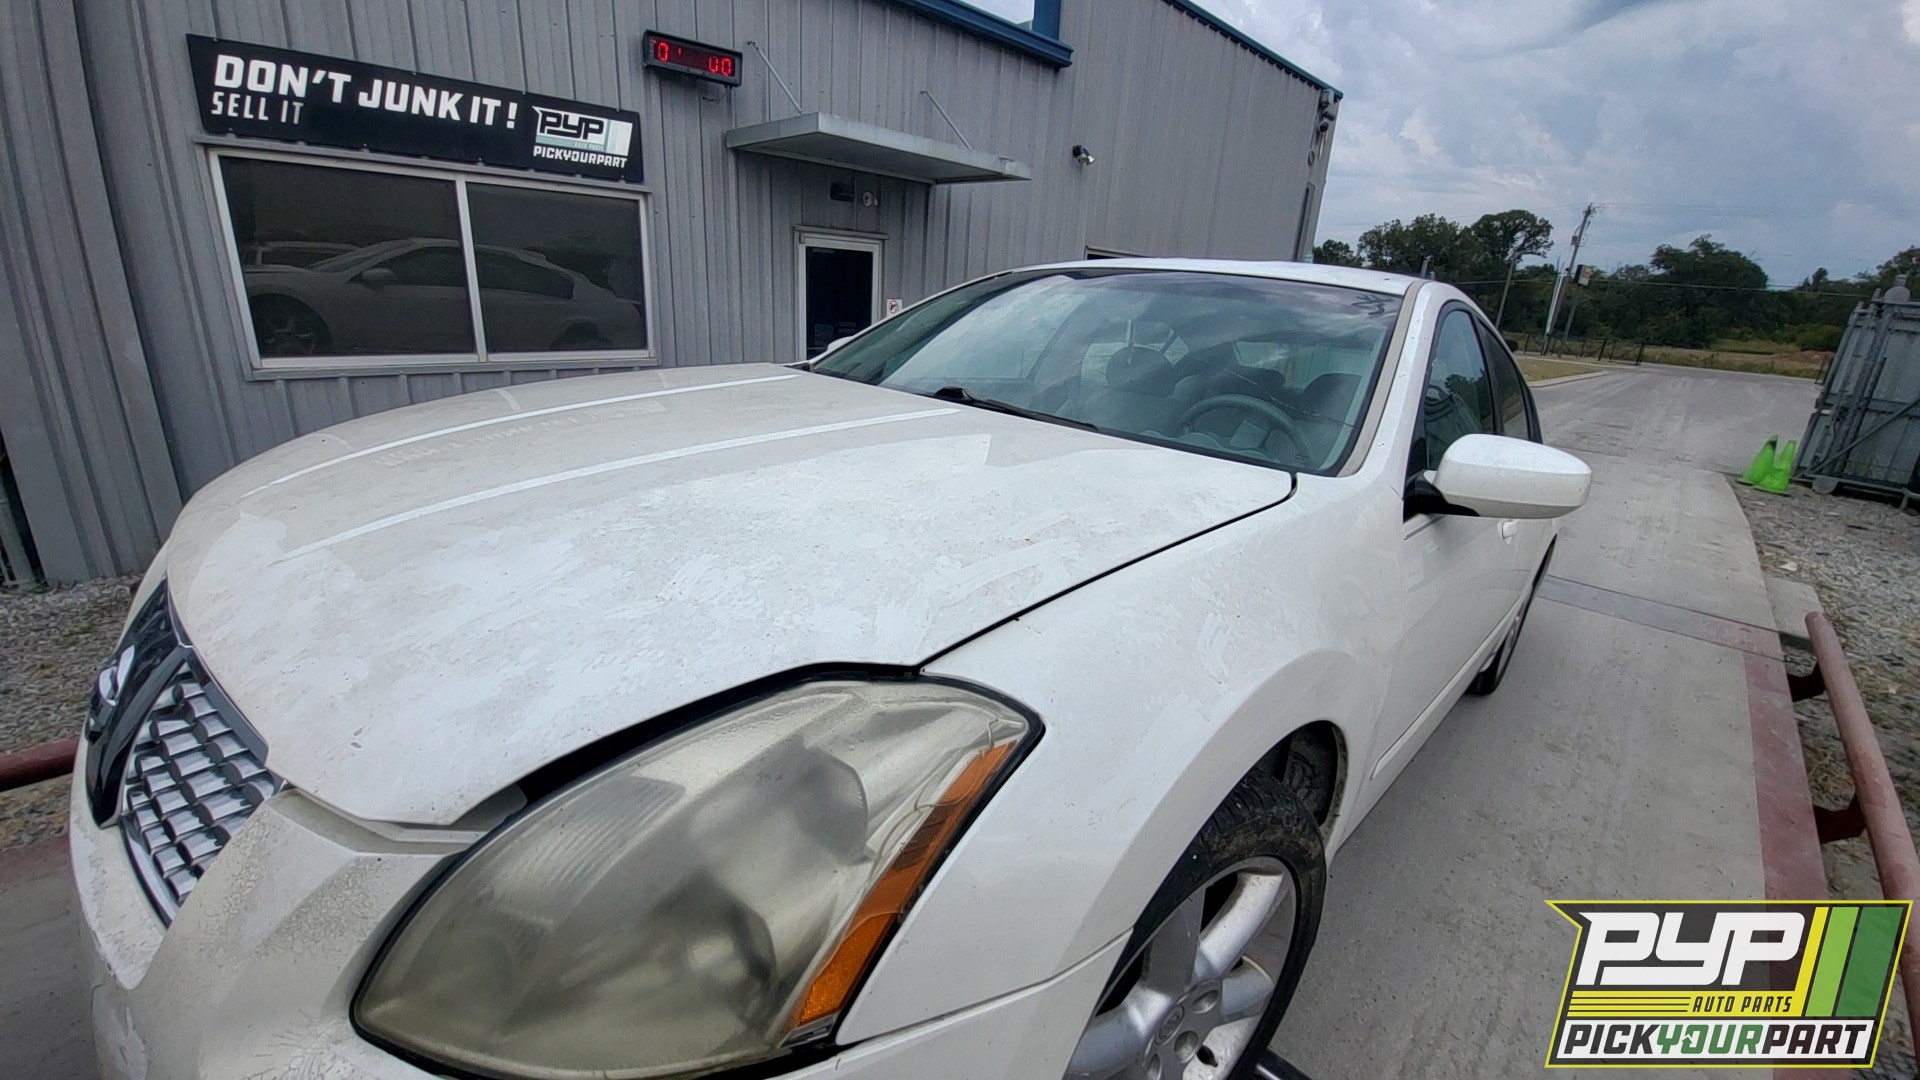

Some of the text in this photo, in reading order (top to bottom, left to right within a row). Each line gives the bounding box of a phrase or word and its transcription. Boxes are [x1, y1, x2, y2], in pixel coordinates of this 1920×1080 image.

[214, 54, 352, 103] DON'T
[358, 79, 464, 121] JUNK
[211, 91, 304, 125] SELL IT
[539, 110, 605, 140] PYP
[533, 145, 628, 168] PICKYOURPART
